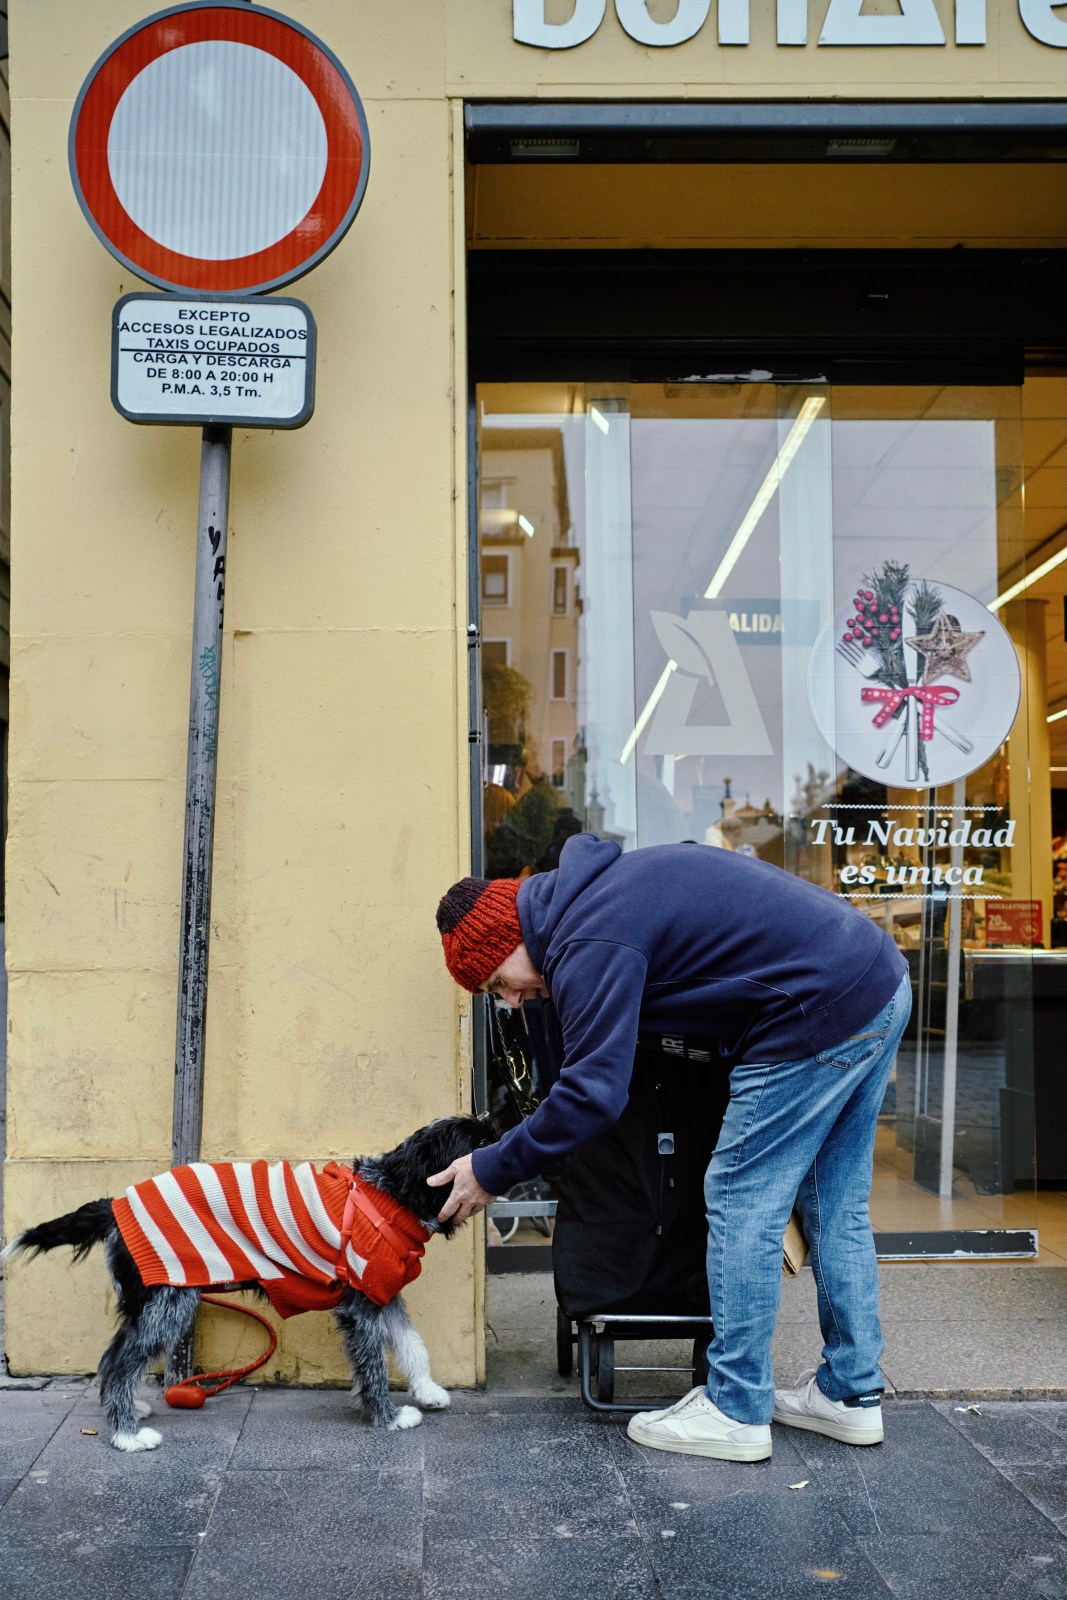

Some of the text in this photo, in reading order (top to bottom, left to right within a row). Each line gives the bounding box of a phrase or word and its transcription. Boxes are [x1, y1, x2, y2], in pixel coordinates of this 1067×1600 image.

[178, 309, 250, 323] EXCEPTO
[119, 322, 308, 340] ACCESOS LEGALIZADOS
[146, 337, 280, 354] TAXIS OCUPADOS
[133, 352, 291, 369] CARGA Y DESCARGA
[146, 367, 274, 383] DE 8:00 A 20:00 H
[161, 383, 262, 398] P.M.A. 3,5 Tm.
[728, 612, 785, 633] ALIDA
[810, 819, 1017, 848] Tu Navidad
[840, 864, 876, 885] es
